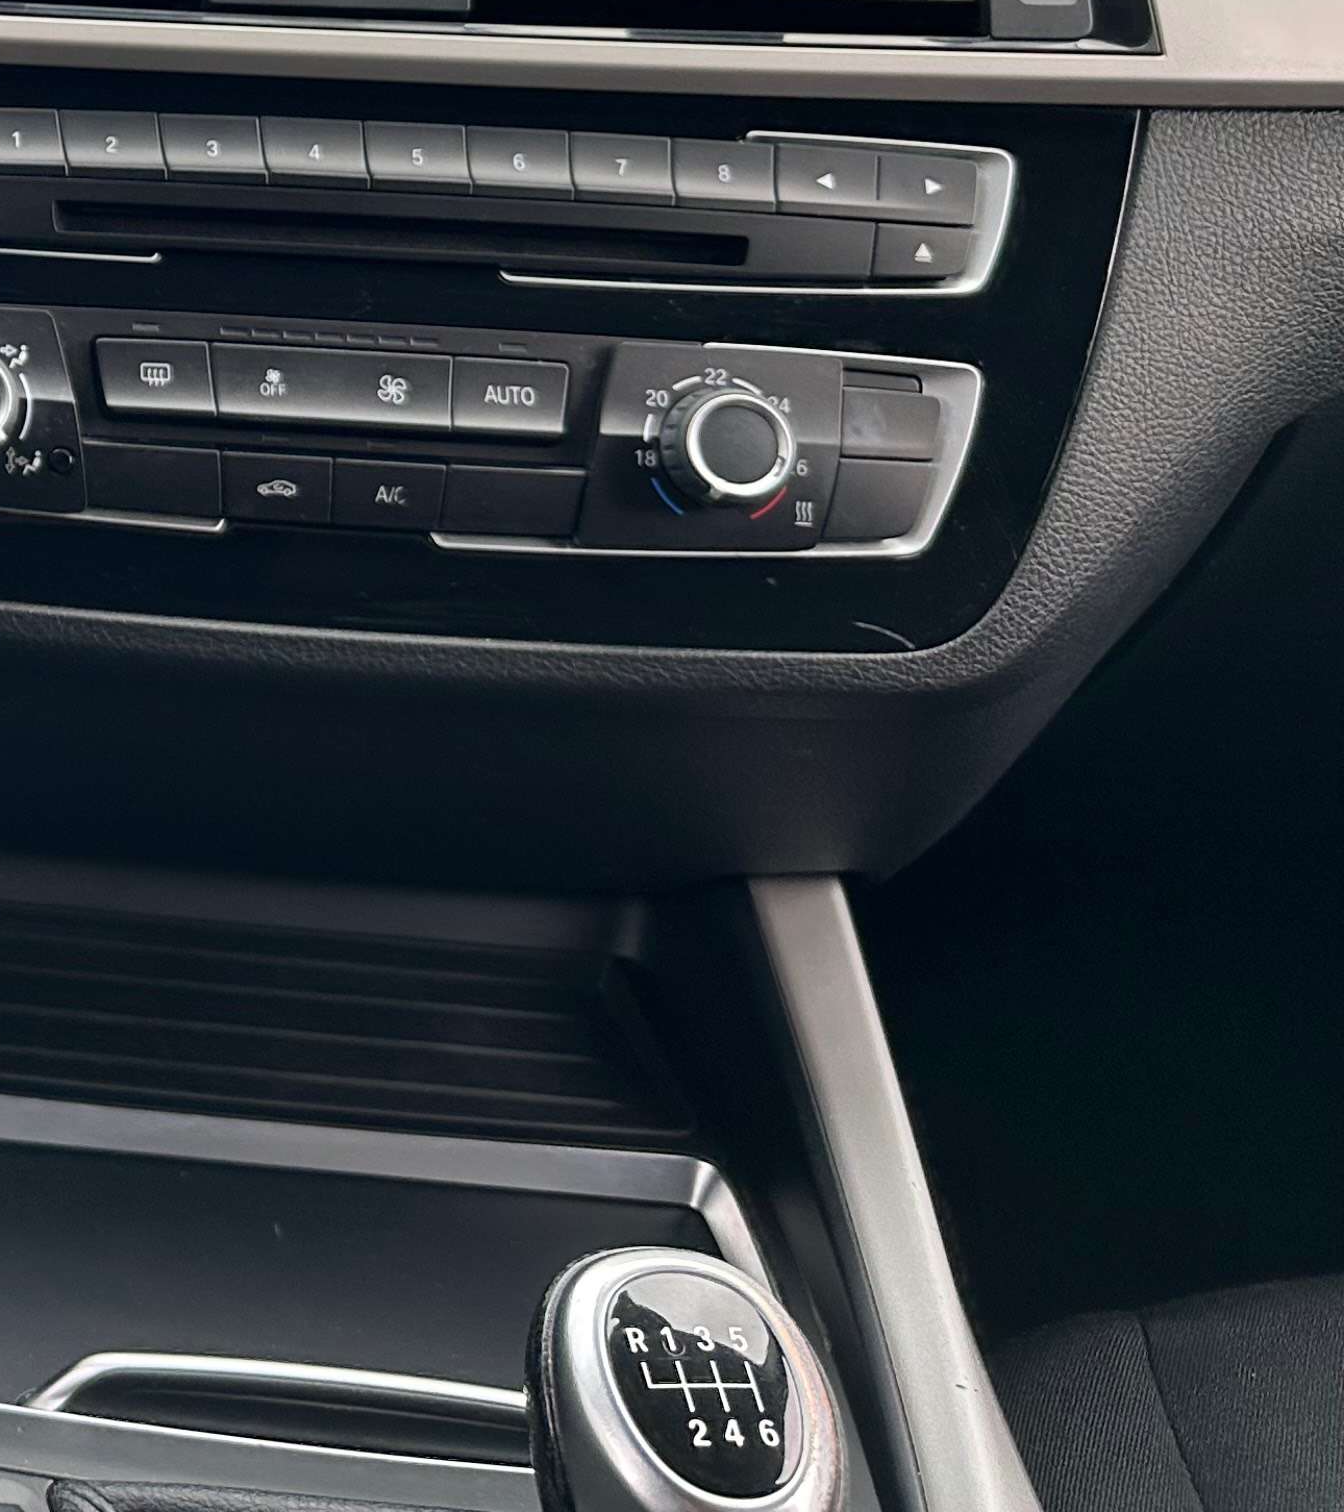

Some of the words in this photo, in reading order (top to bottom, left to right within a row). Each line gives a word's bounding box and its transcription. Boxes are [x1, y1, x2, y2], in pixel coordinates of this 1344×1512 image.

[11, 131, 23, 149] 1
[105, 136, 119, 155] 2
[205, 140, 220, 158] 3
[307, 143, 322, 162] 4
[411, 148, 425, 167] 5
[512, 152, 527, 172] 6
[615, 158, 629, 177] 7
[717, 164, 732, 183] 8
[704, 368, 729, 386] 22
[259, 382, 286, 397] OFF
[483, 384, 536, 407] AUTO
[645, 389, 668, 408] 20
[634, 449, 657, 468] 18
[375, 484, 408, 506] A/C
[624, 1326, 649, 1353] R
[659, 1326, 678, 1351] 1
[693, 1325, 716, 1352] 3
[727, 1326, 749, 1352] 5
[687, 1418, 713, 1447] 2
[724, 1418, 746, 1448] 4
[758, 1419, 780, 1447] 6
